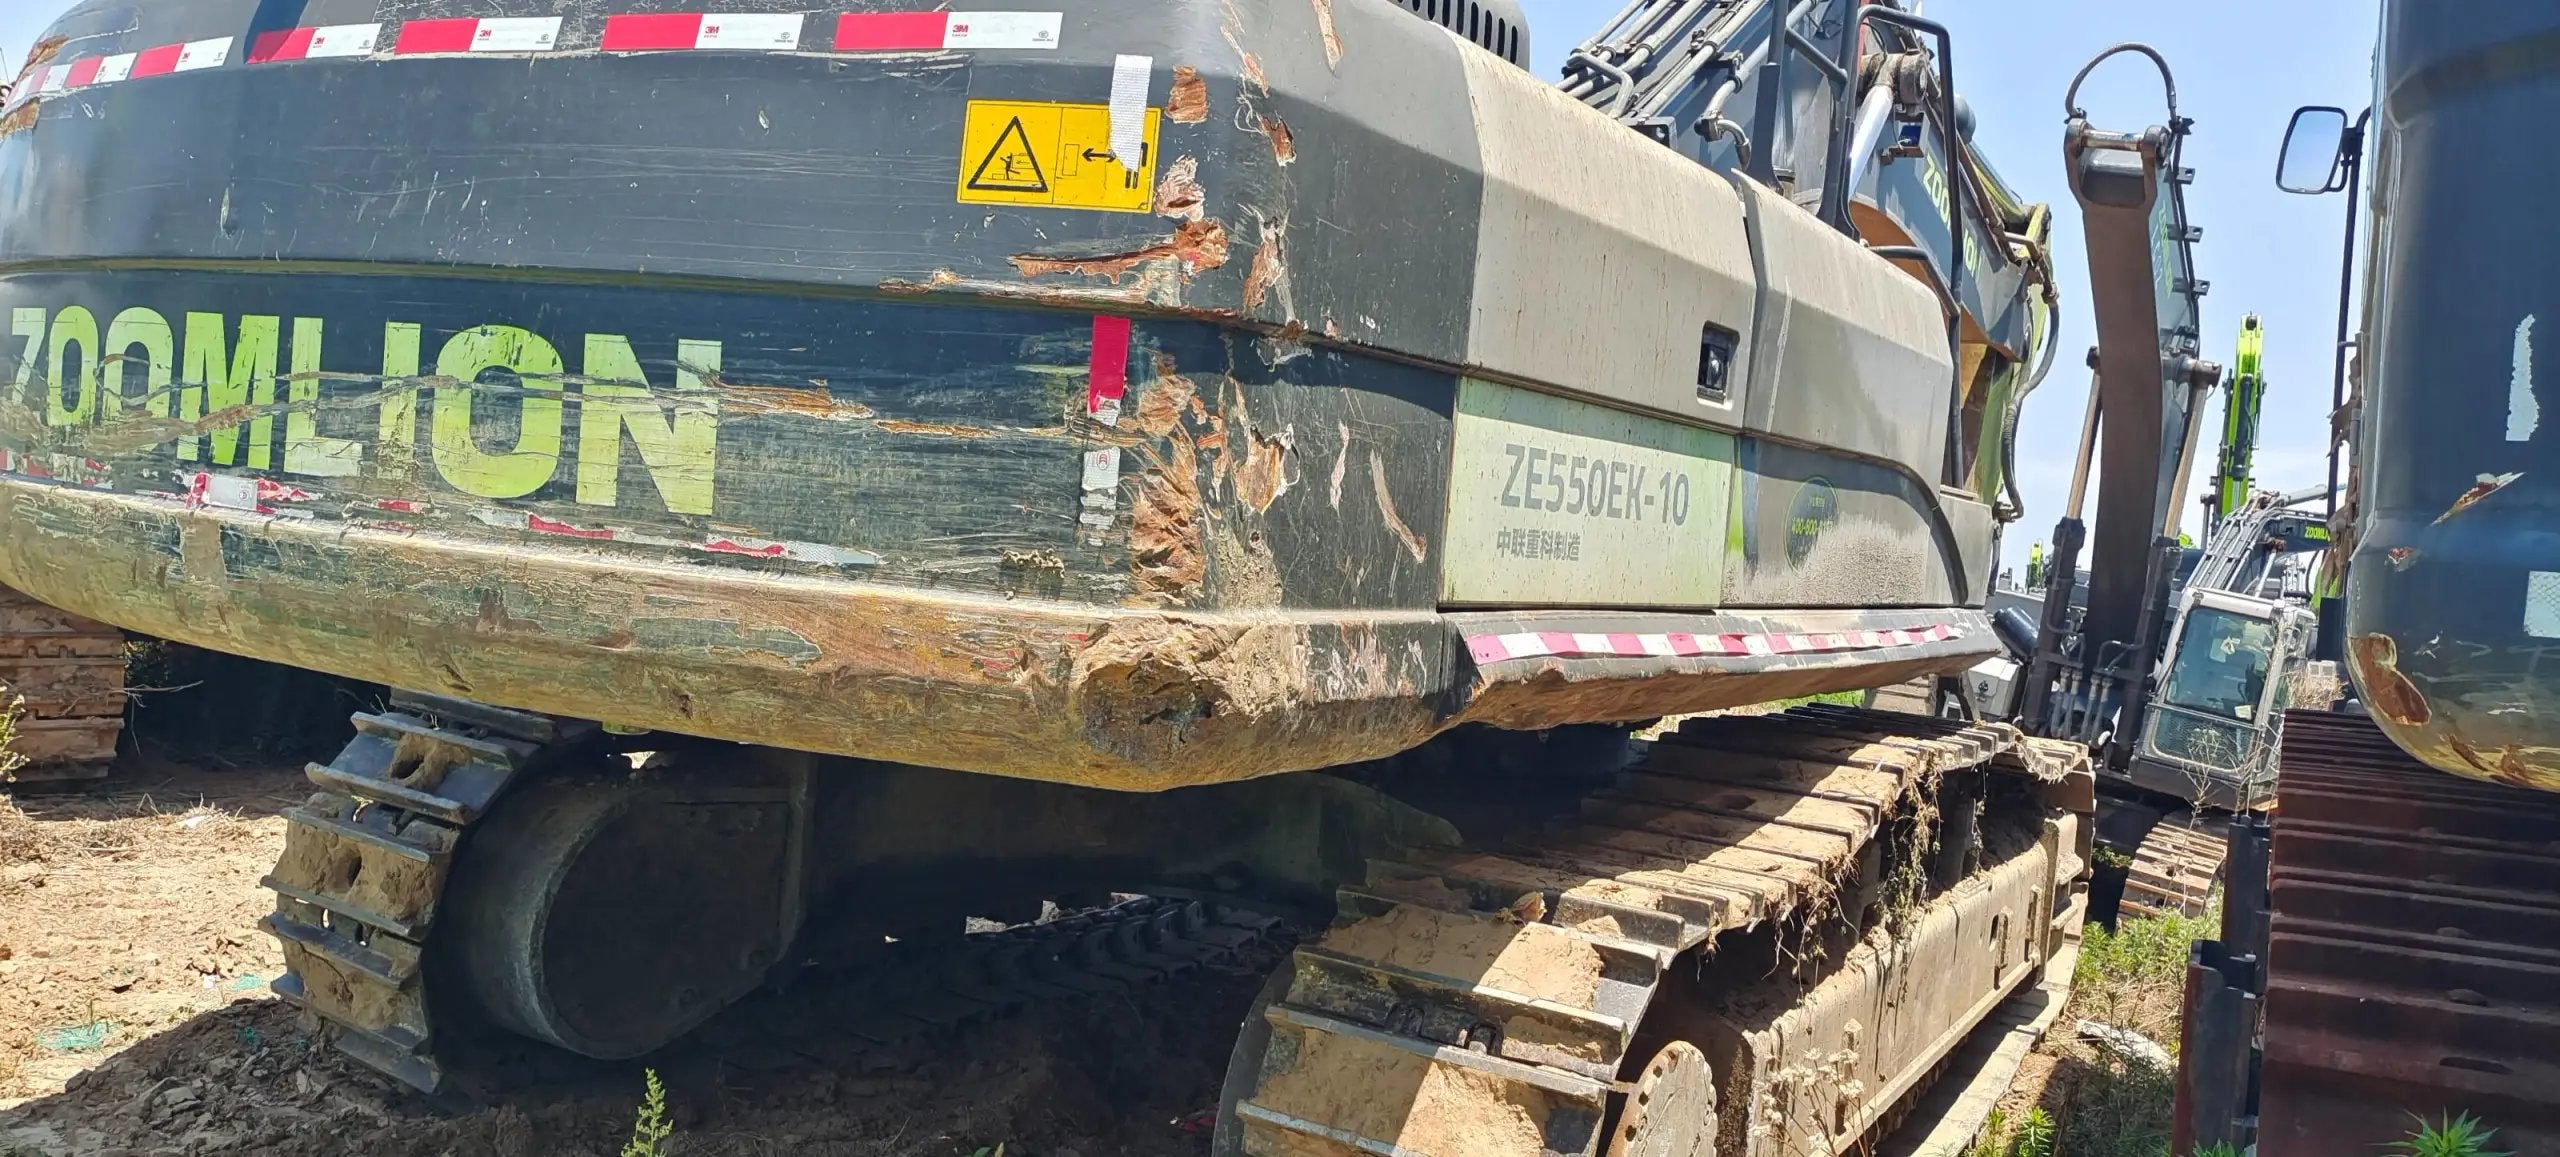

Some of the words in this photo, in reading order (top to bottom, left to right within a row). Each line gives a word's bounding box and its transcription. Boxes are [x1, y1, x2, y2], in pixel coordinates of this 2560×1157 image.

[1923, 151, 1982, 281] ZOOION
[11, 305, 722, 515] ZOOMLION
[1501, 443, 1689, 526] ZE550EK-10
[1496, 527, 1580, 561] 中联重科制造
